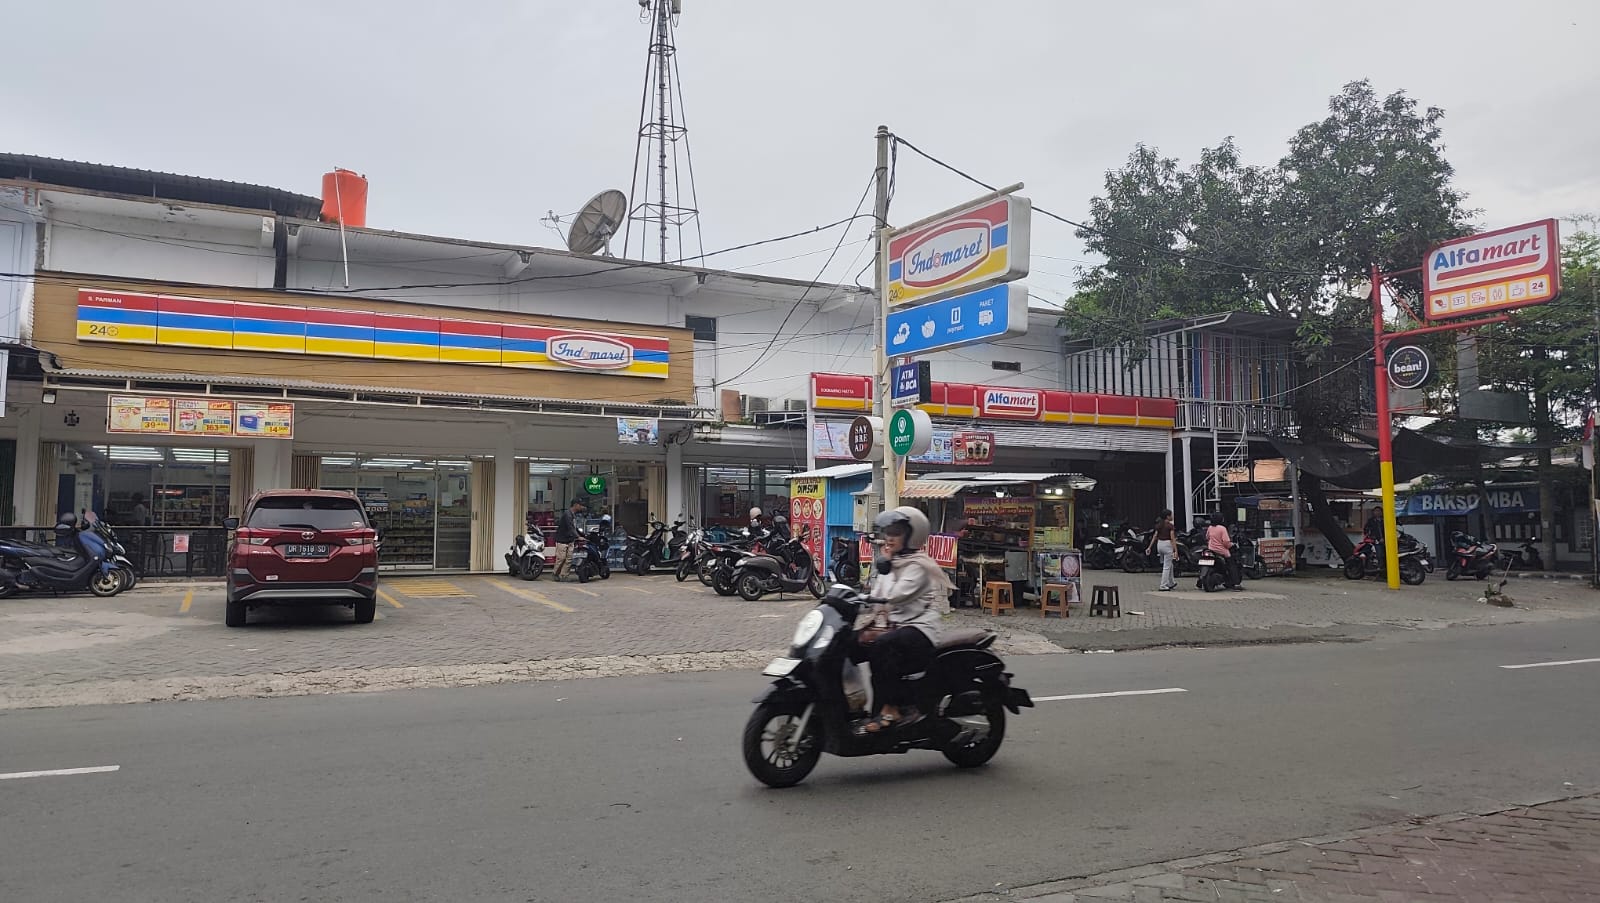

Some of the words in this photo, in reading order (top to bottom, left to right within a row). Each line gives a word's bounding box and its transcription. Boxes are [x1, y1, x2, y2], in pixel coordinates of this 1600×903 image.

[908, 233, 983, 275] Indomaret
[1433, 234, 1541, 271] Alfamart
[1531, 281, 1544, 290] 24
[95, 296, 122, 304] PARMAN
[89, 324, 106, 336] 24
[554, 342, 625, 361] Indomaret
[1394, 360, 1422, 373] bean!
[900, 368, 914, 381] ATM
[905, 379, 917, 391] BCA
[987, 391, 1037, 407] Alfamart
[854, 425, 868, 434] SAY
[854, 433, 868, 443] BRE
[854, 443, 864, 452] AD
[1421, 493, 1480, 511] BAKSO
[928, 535, 955, 562] BULAN
